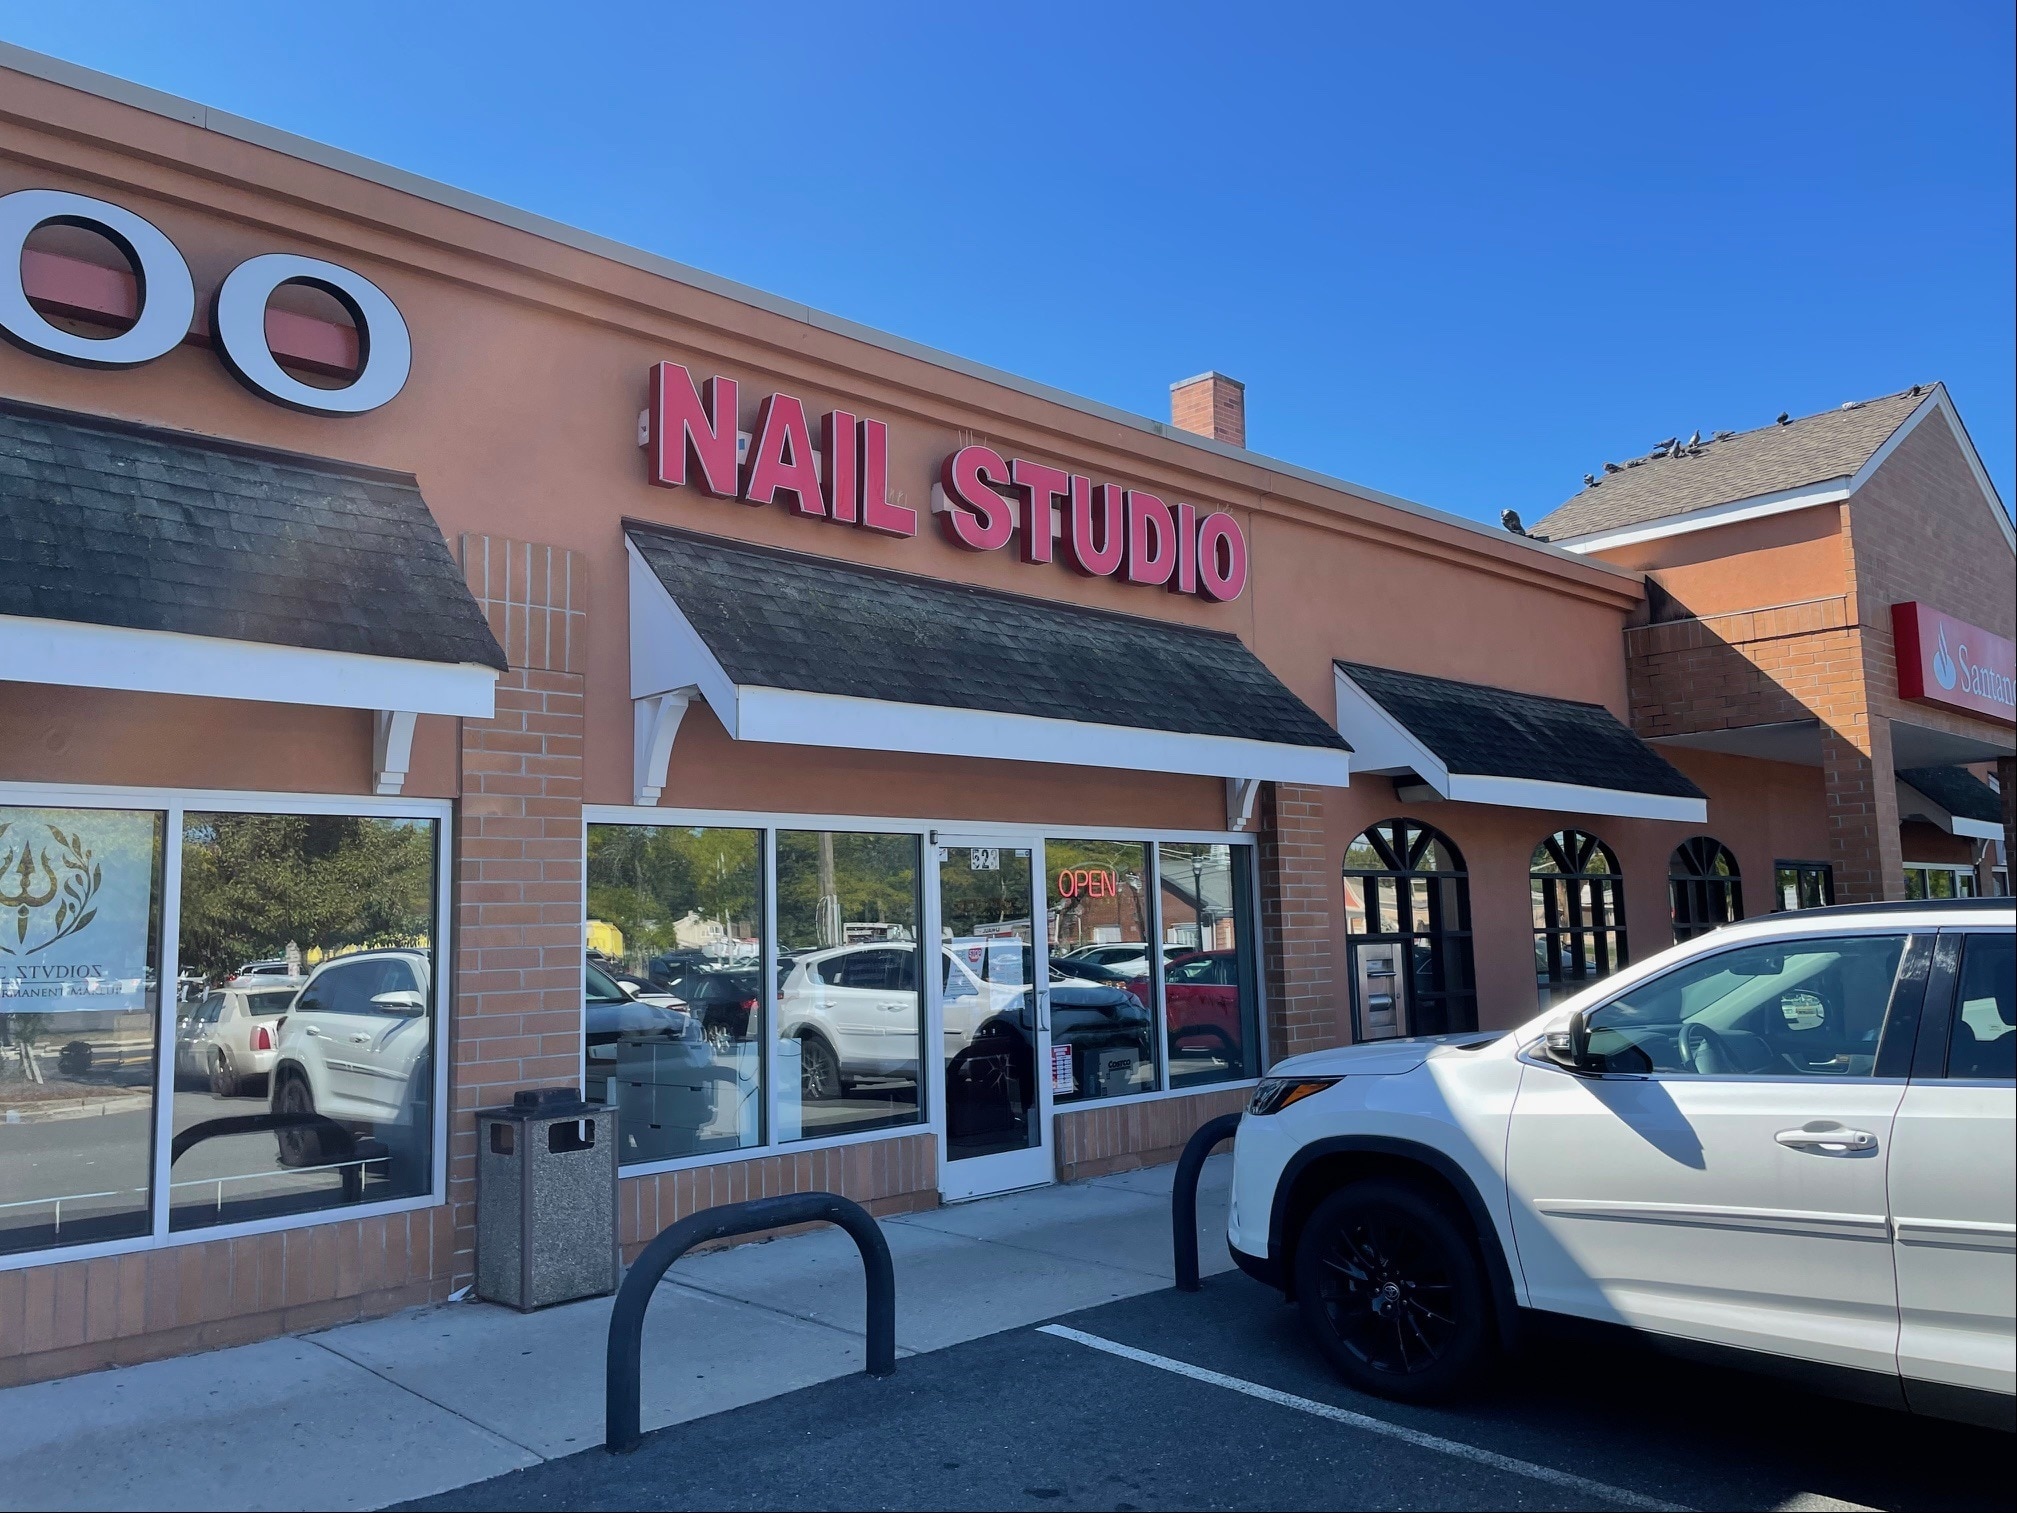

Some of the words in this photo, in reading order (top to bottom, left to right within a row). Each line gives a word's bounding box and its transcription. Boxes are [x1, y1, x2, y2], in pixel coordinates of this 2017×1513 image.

[649, 360, 918, 538] NAIL
[941, 444, 1249, 602] STUDIO
[1958, 644, 2016, 706] Santan
[1058, 869, 1116, 898] OPEN
